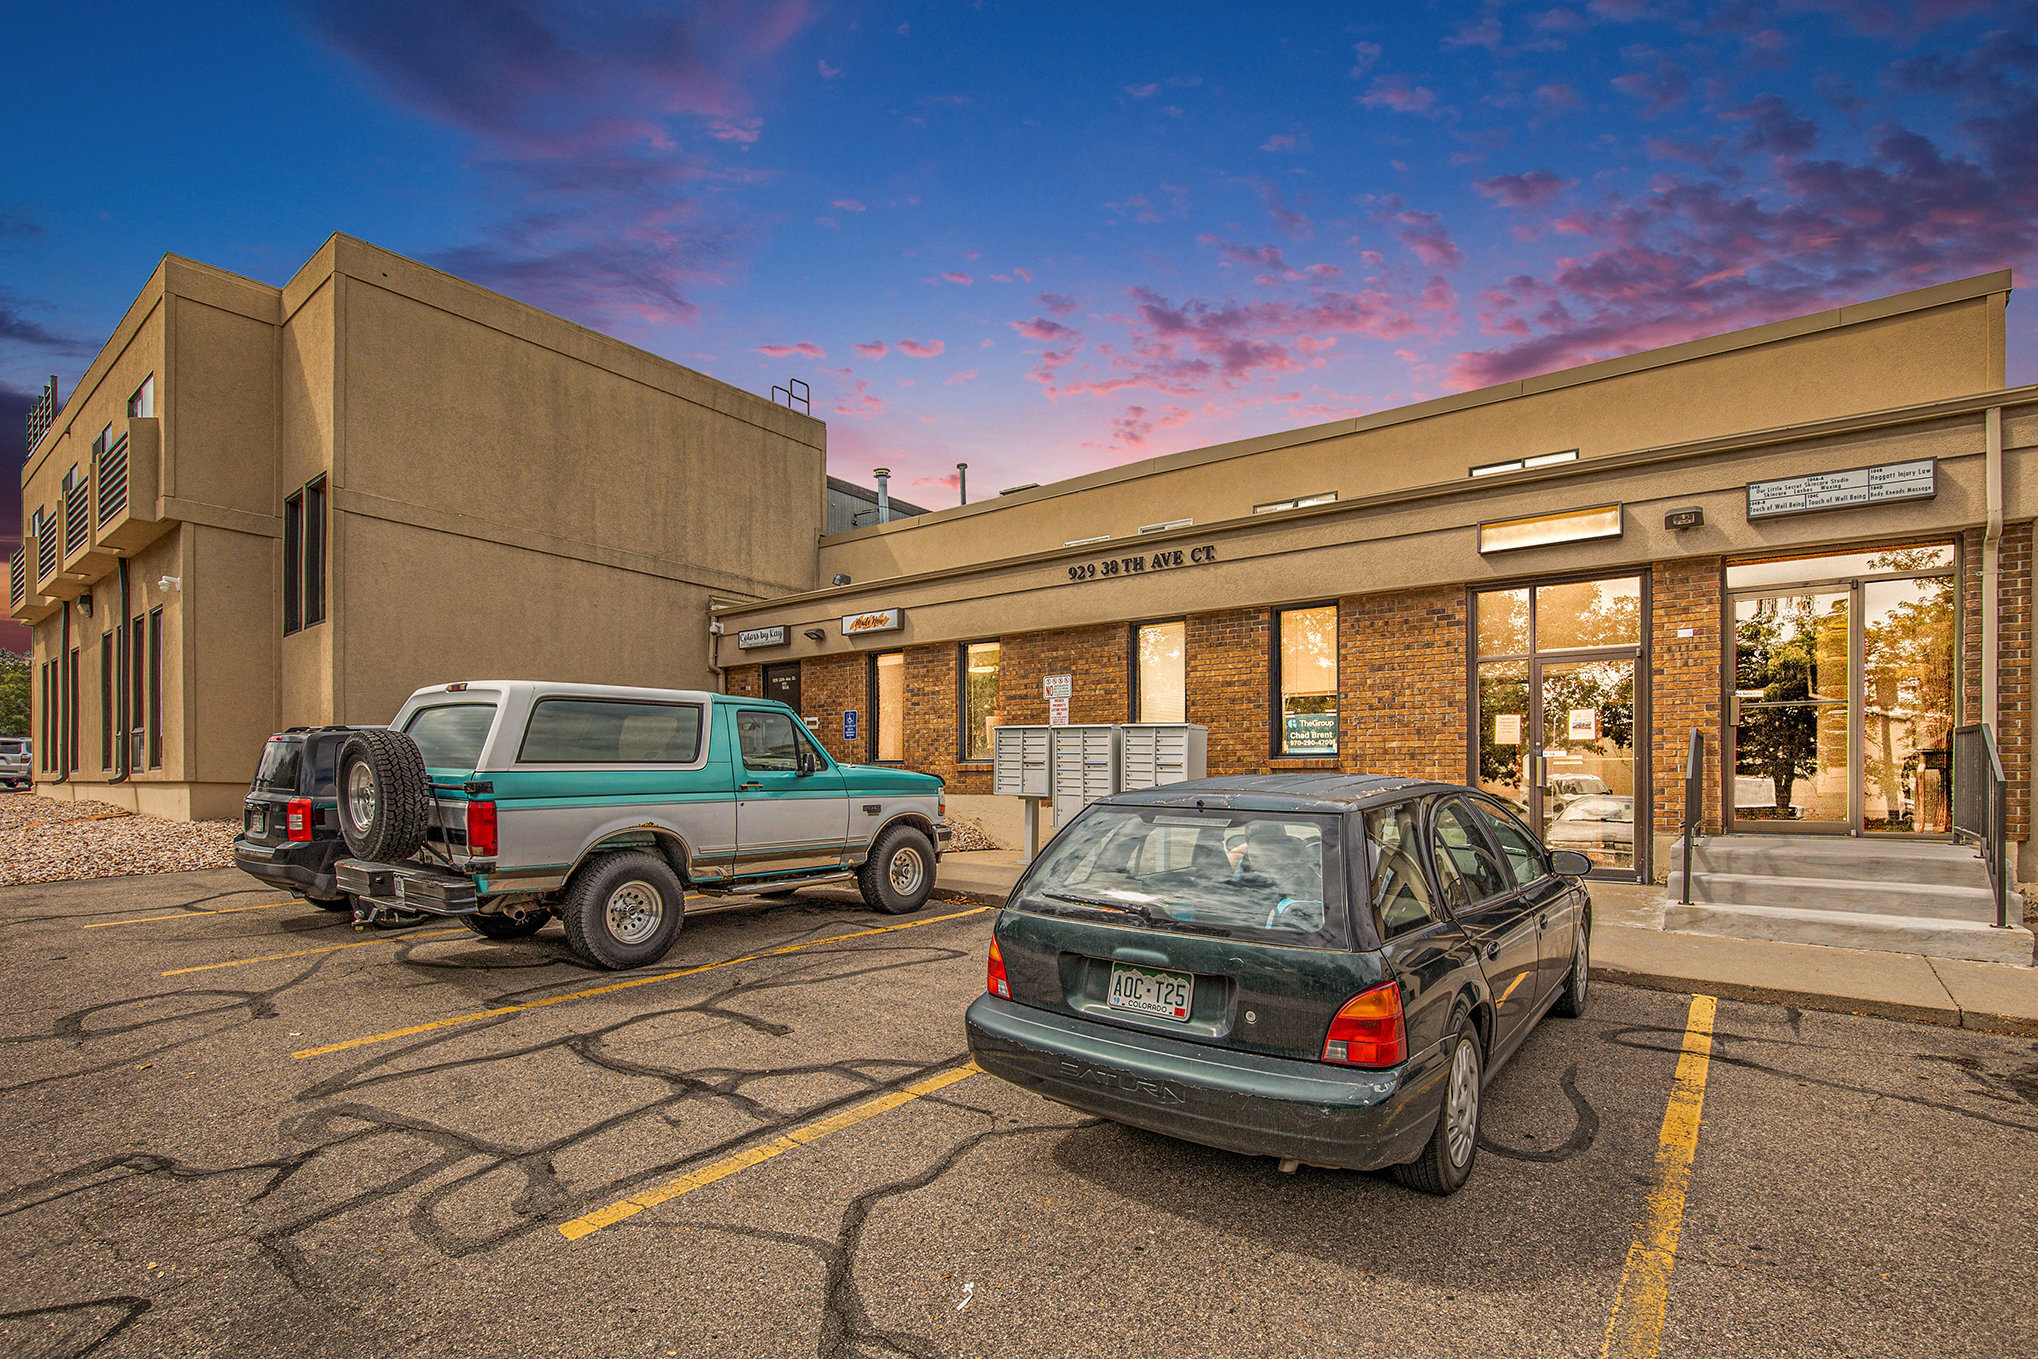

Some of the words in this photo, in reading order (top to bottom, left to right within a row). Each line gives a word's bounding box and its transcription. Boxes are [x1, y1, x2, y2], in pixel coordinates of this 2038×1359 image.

[1835, 494, 1848, 502] Well
[1068, 563, 1095, 580] 929
[1150, 550, 1184, 568] AVE
[1190, 545, 1215, 563] CT.
[740, 633, 760, 643] Colors
[760, 630, 769, 641] by
[769, 628, 783, 640] Kay
[1046, 685, 1054, 697] NO
[1299, 719, 1335, 728] TheGroup
[1290, 731, 1310, 739] Chad
[1311, 731, 1333, 739] Brent
[1128, 999, 1168, 1013] COLORADO
[1060, 1062, 1185, 1104] SATURN
